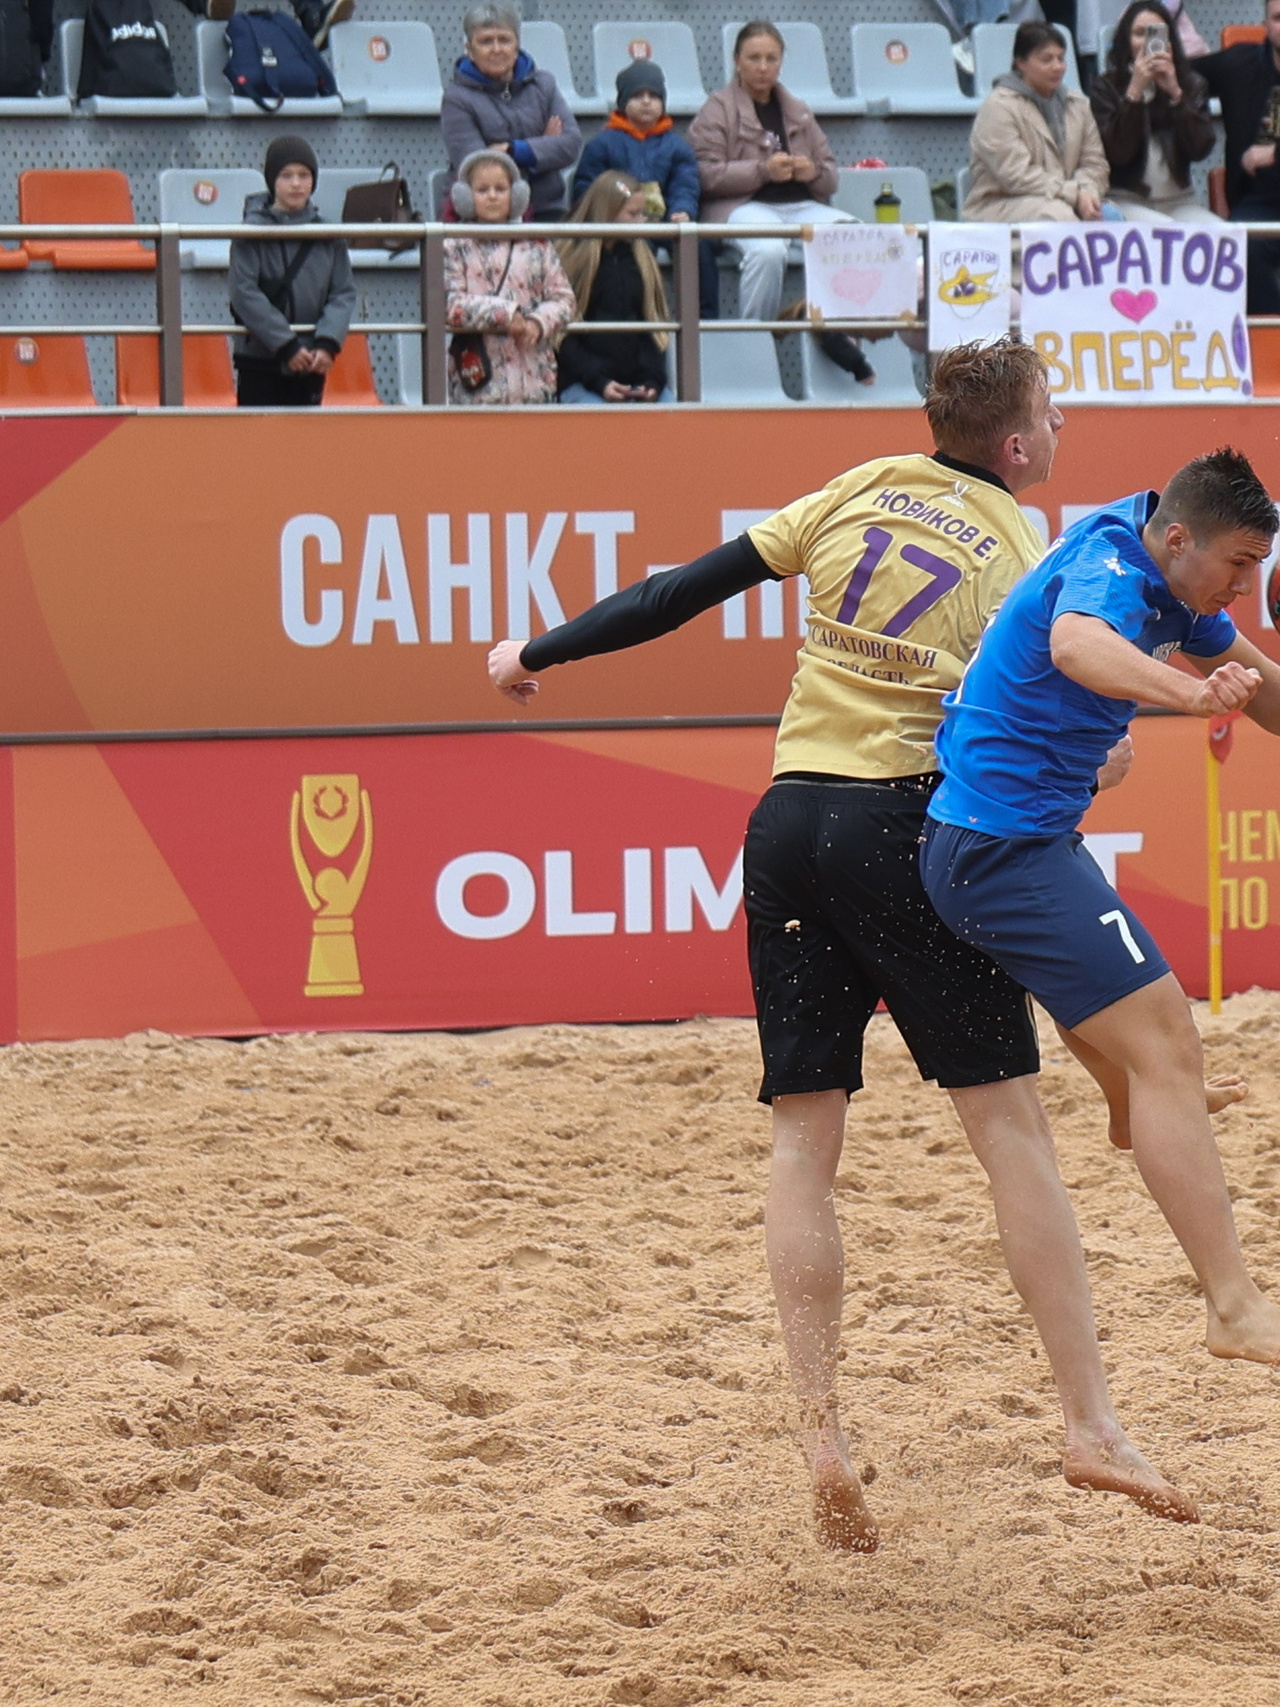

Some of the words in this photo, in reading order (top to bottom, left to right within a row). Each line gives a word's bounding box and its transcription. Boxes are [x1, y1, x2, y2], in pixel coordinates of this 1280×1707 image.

[942, 251, 997, 267] САРАТОВ
[1022, 228, 1244, 296] САРАТОВ
[872, 488, 980, 544] НОВИКОВ
[836, 526, 962, 638] 17
[811, 626, 938, 669] САРАТОВСКАЯ
[1098, 909, 1146, 965] 7
